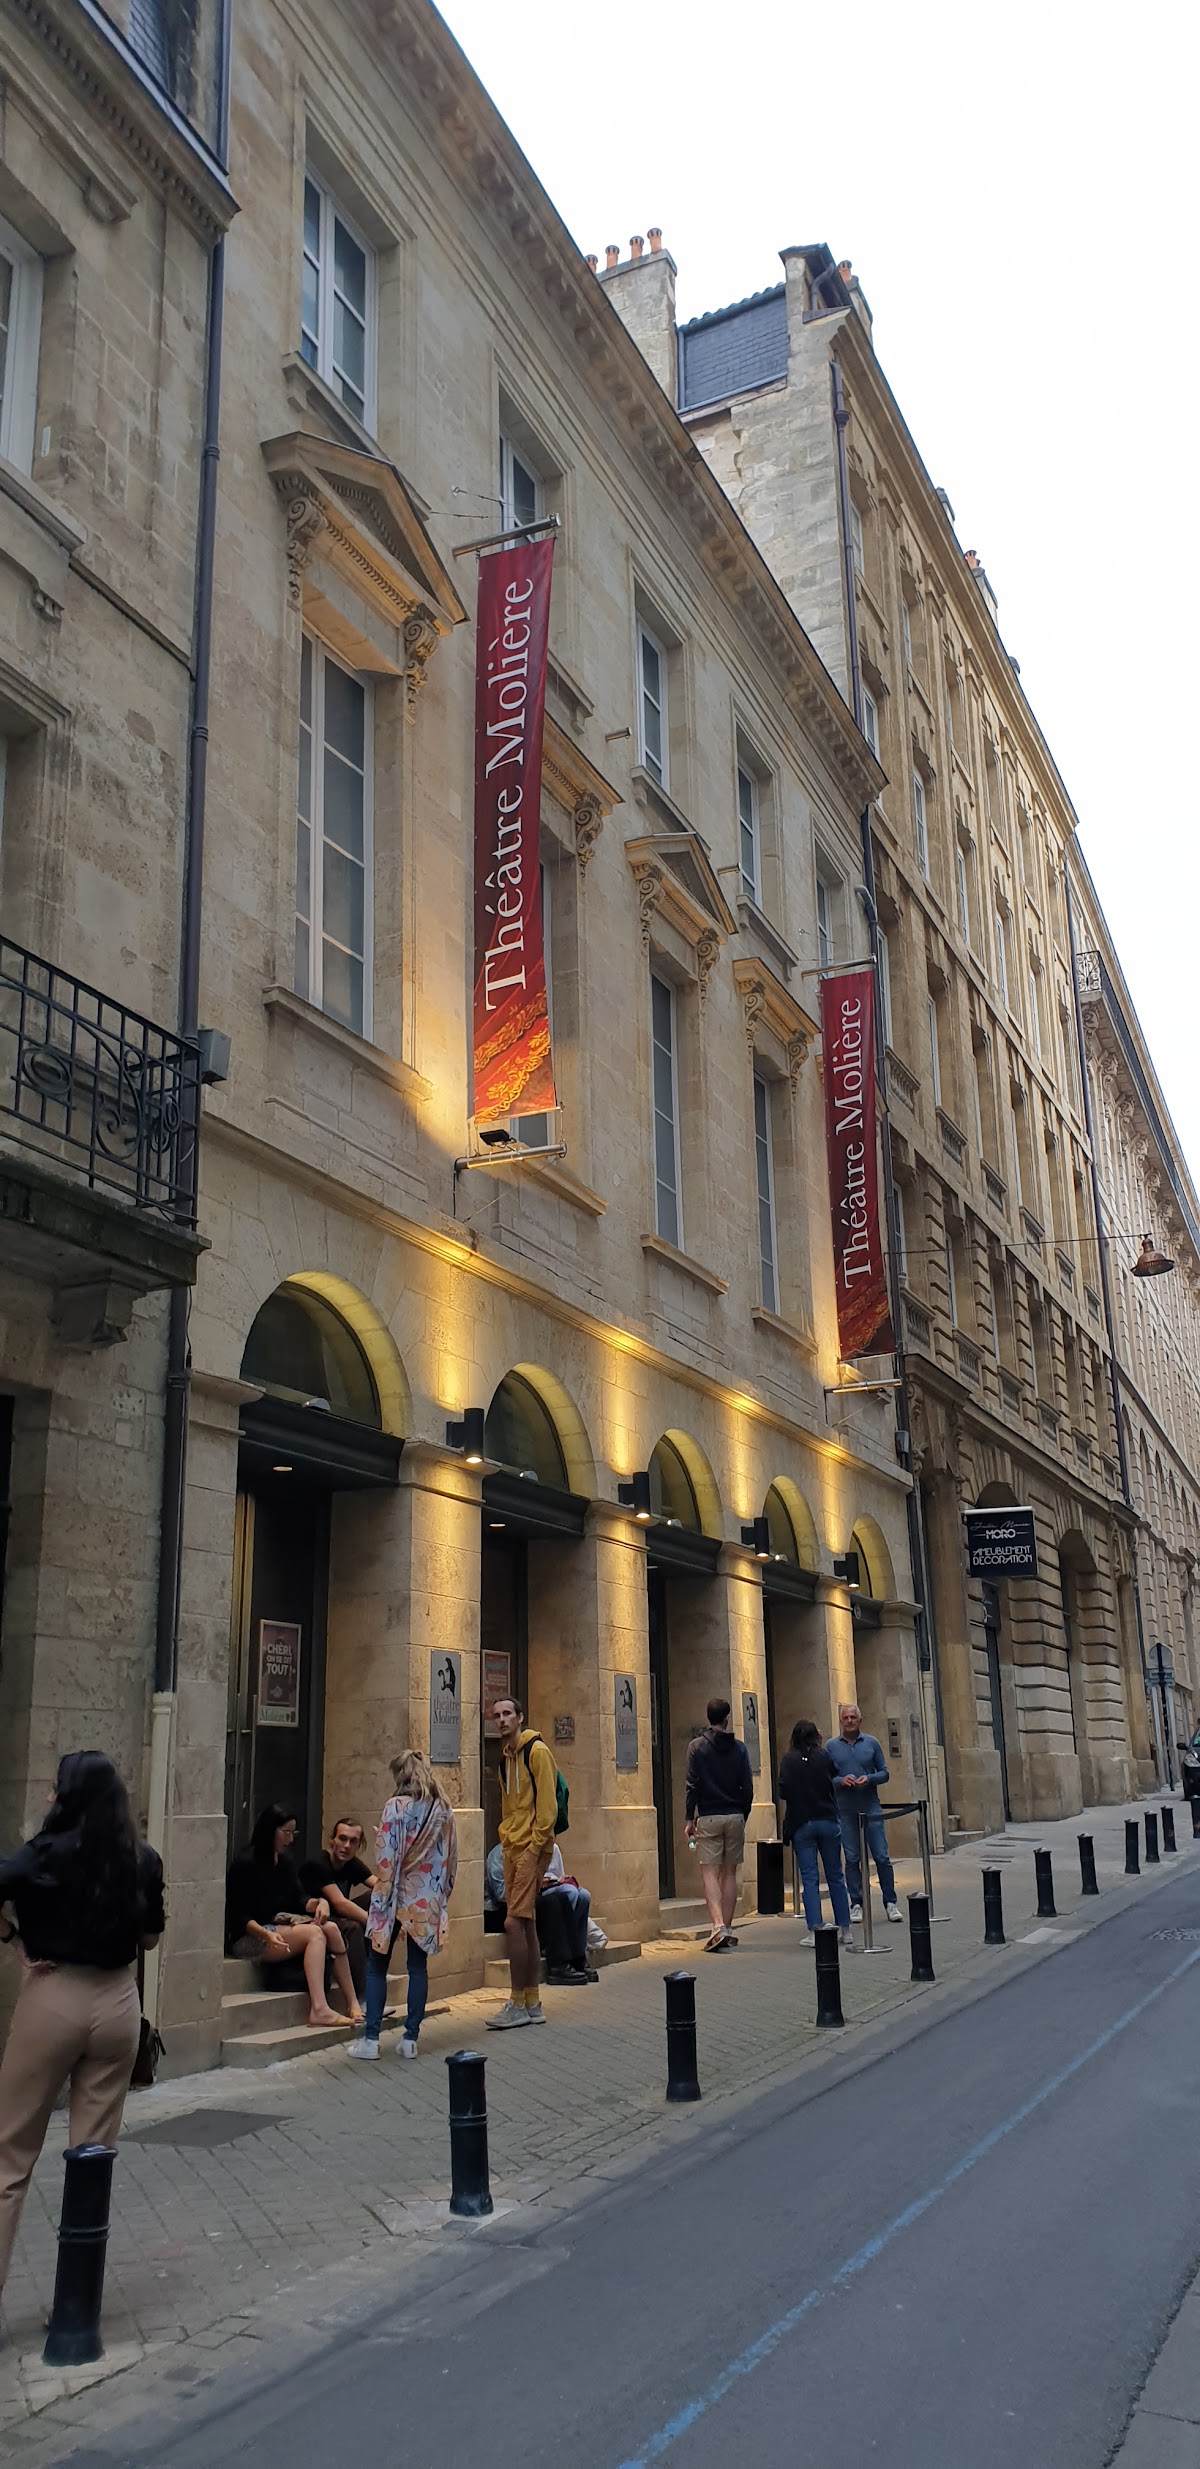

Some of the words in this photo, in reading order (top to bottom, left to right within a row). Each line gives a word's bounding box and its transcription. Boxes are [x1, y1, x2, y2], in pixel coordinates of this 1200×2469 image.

[485, 577, 535, 782] Molière
[485, 784, 530, 1013] Théâtre
[832, 997, 864, 1136] Molière
[840, 1142, 873, 1289] Théâtre
[973, 1546, 1031, 1556] AMEUBLEMENT
[973, 1554, 1033, 1565] DECORATION
[985, 1529, 1016, 1540] MORO
